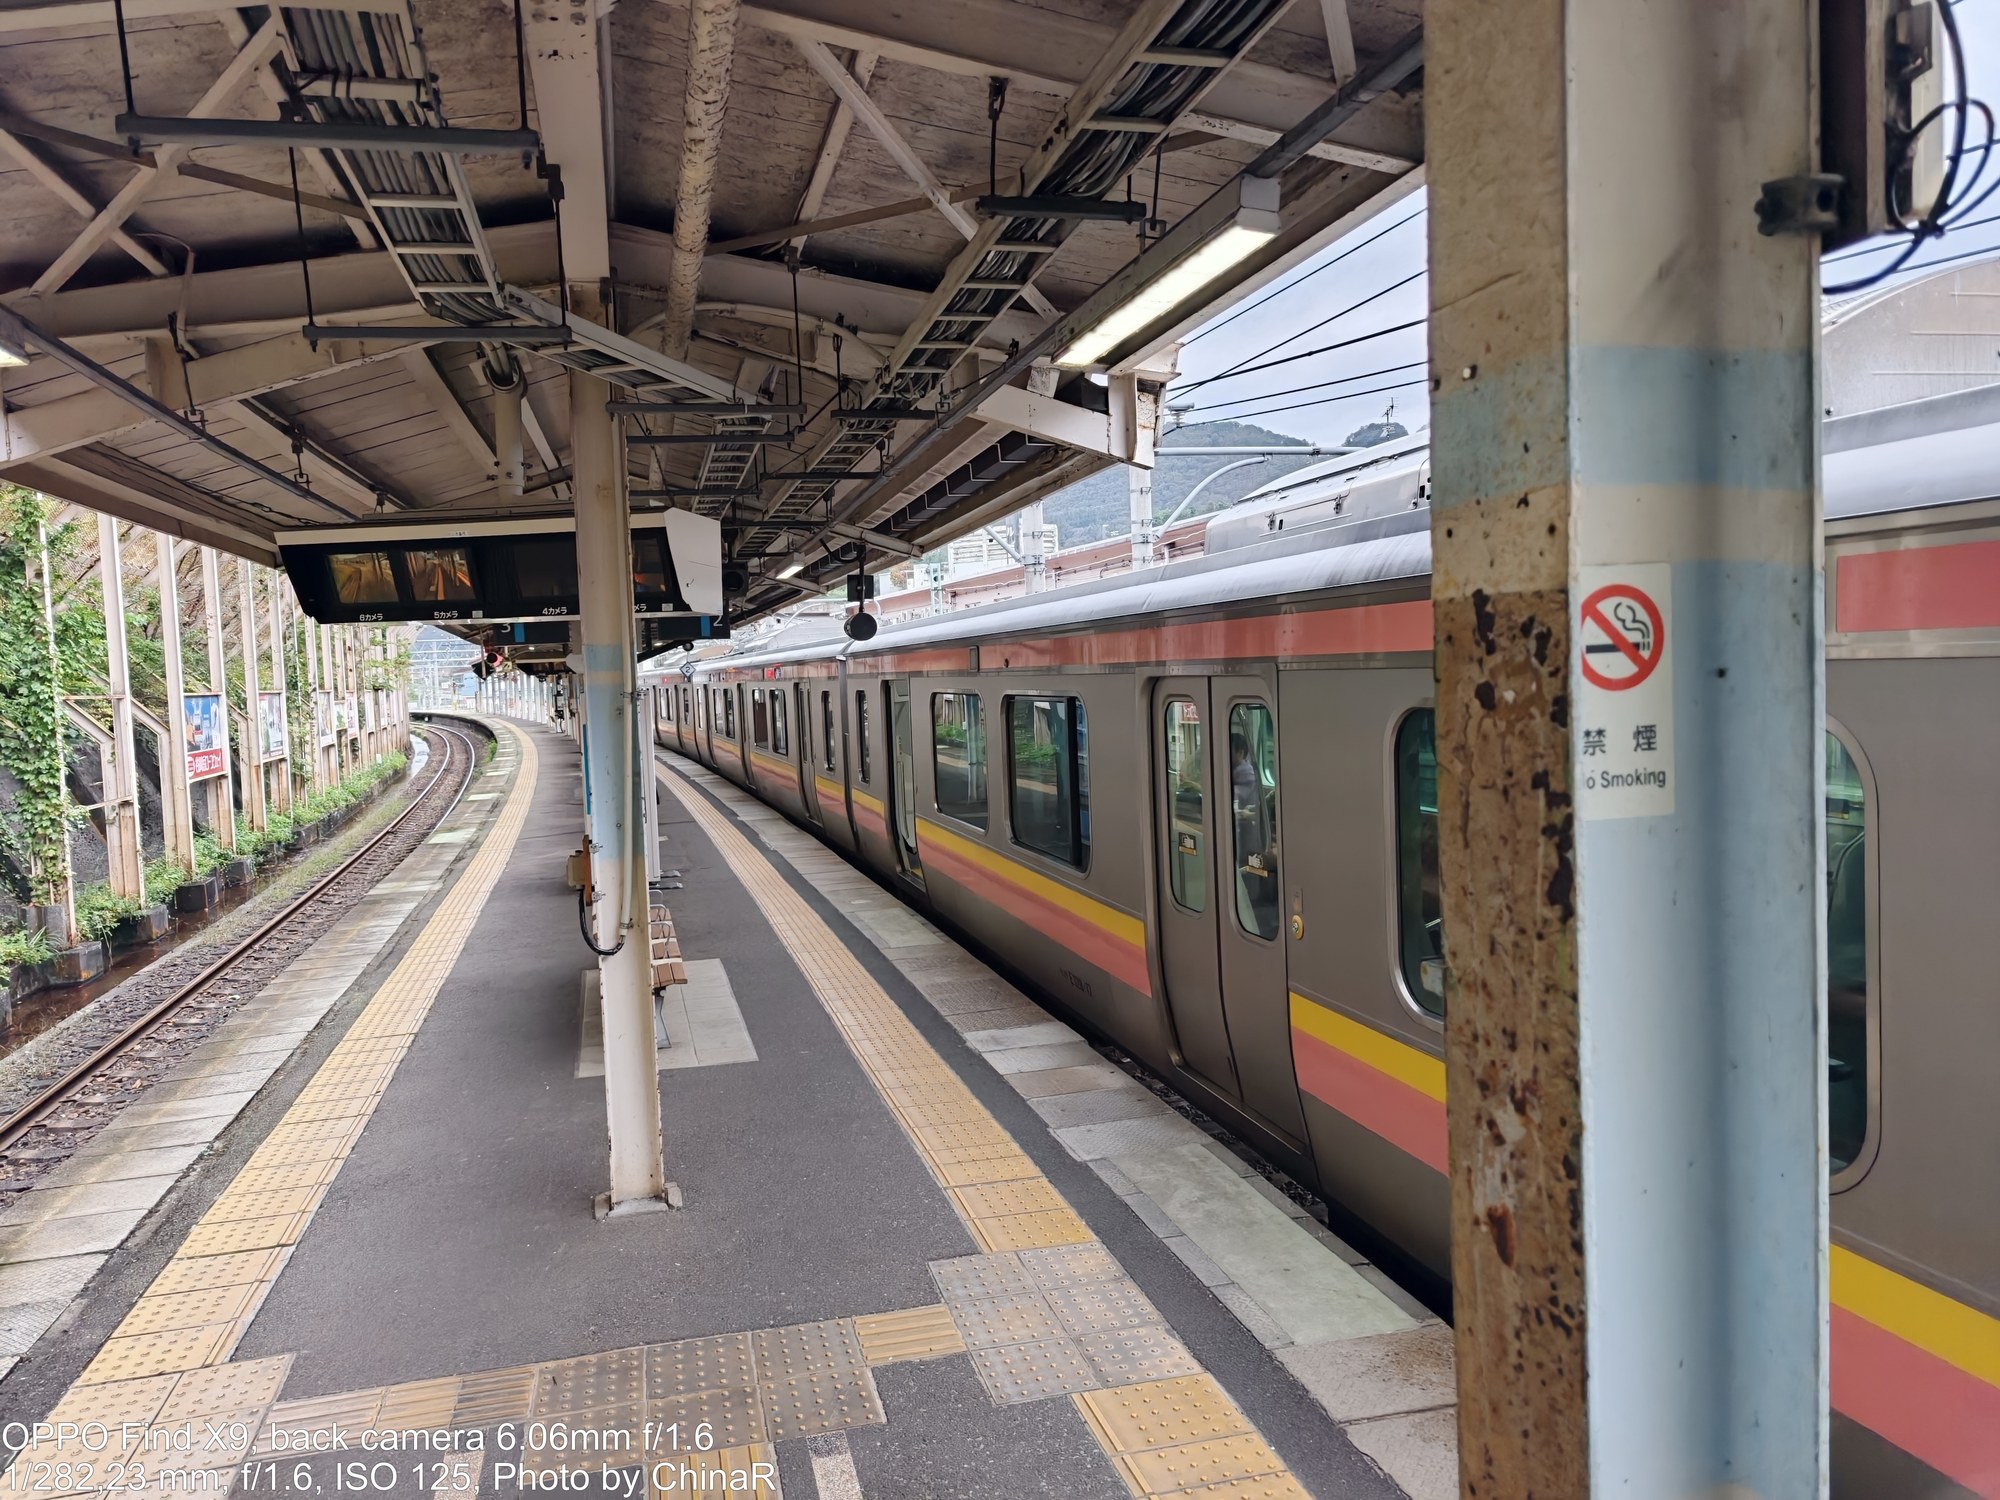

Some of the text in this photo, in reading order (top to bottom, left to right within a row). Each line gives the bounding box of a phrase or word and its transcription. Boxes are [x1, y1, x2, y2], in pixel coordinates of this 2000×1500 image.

[434, 610, 458, 619] 5カメラ
[542, 606, 567, 615] 4カメラ
[359, 613, 383, 621] 6カメラ
[685, 666, 691, 674] 2
[1583, 724, 1657, 756] 禁煙
[1601, 768, 1666, 788] Smoking
